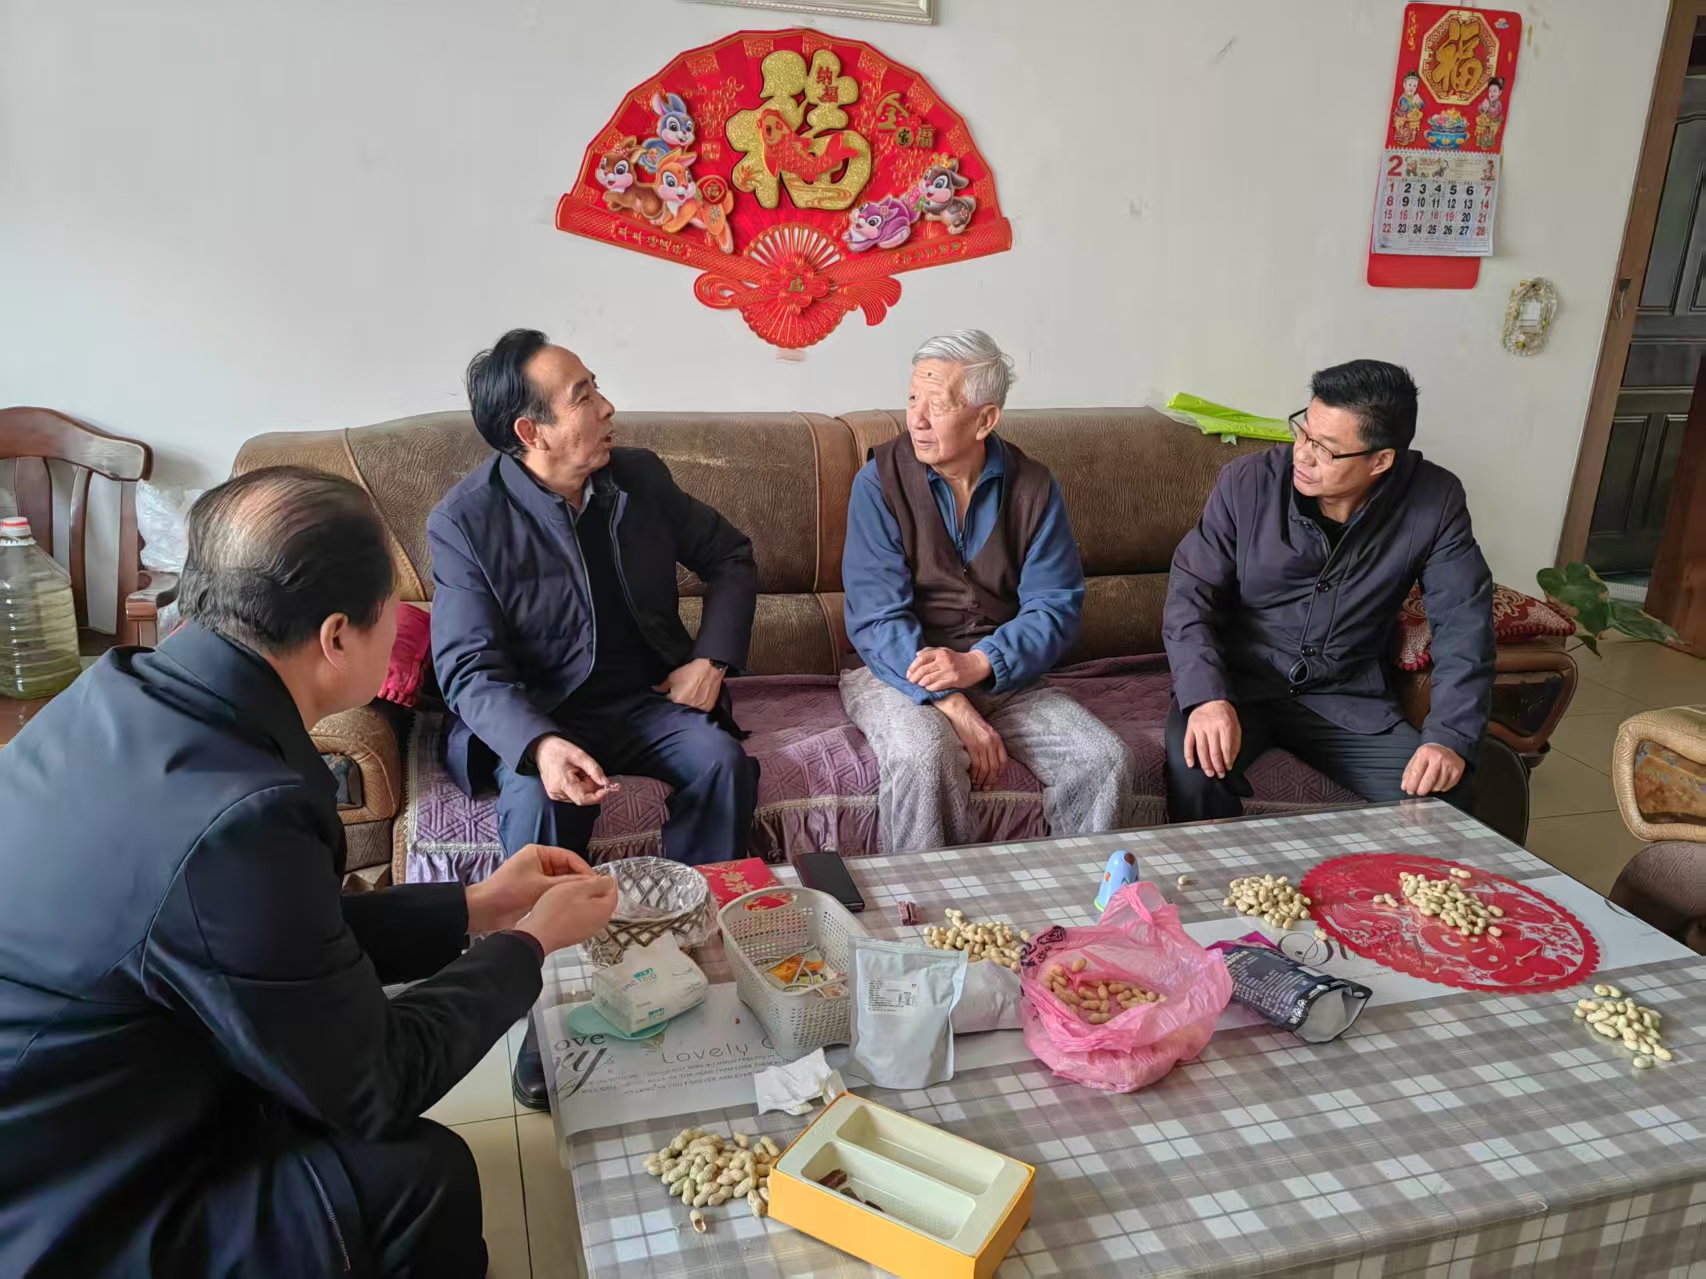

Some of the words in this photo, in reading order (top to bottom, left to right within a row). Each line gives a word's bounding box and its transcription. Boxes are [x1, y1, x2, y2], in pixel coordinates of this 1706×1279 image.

[1431, 19, 1484, 93] 福
[816, 65, 839, 103] 纳福
[725, 50, 871, 210] 福
[1387, 155, 1403, 177] 2
[1390, 182, 1394, 192] 1
[1404, 183, 1412, 193] 2
[1420, 184, 1427, 194] 3
[1434, 184, 1442, 193] 4
[1449, 185, 1457, 195] 5
[1466, 186, 1474, 195] 6
[1484, 186, 1491, 196] 7
[1386, 196, 1394, 206] 8
[1402, 196, 1410, 207] 9
[1417, 197, 1426, 208] 10
[1432, 199, 1440, 208] 11
[1447, 199, 1456, 209] 12
[1463, 199, 1473, 209] 13
[1480, 200, 1489, 210] 14
[1384, 210, 1392, 219] 15
[1400, 210, 1408, 220] 16
[1416, 211, 1424, 220] 17
[1431, 211, 1439, 220] 18
[1446, 212, 1455, 222] 19
[1461, 212, 1471, 222] 20
[1478, 213, 1487, 223] 21
[1382, 223, 1391, 233] 22
[1397, 224, 1406, 233] 23
[1413, 224, 1422, 234] 24
[1427, 225, 1437, 234] 25
[1443, 225, 1453, 235] 26
[1459, 226, 1469, 236] 27
[1476, 226, 1486, 236] 28
[553, 1033, 605, 1051] ove
[661, 1042, 748, 1064] Lovely
